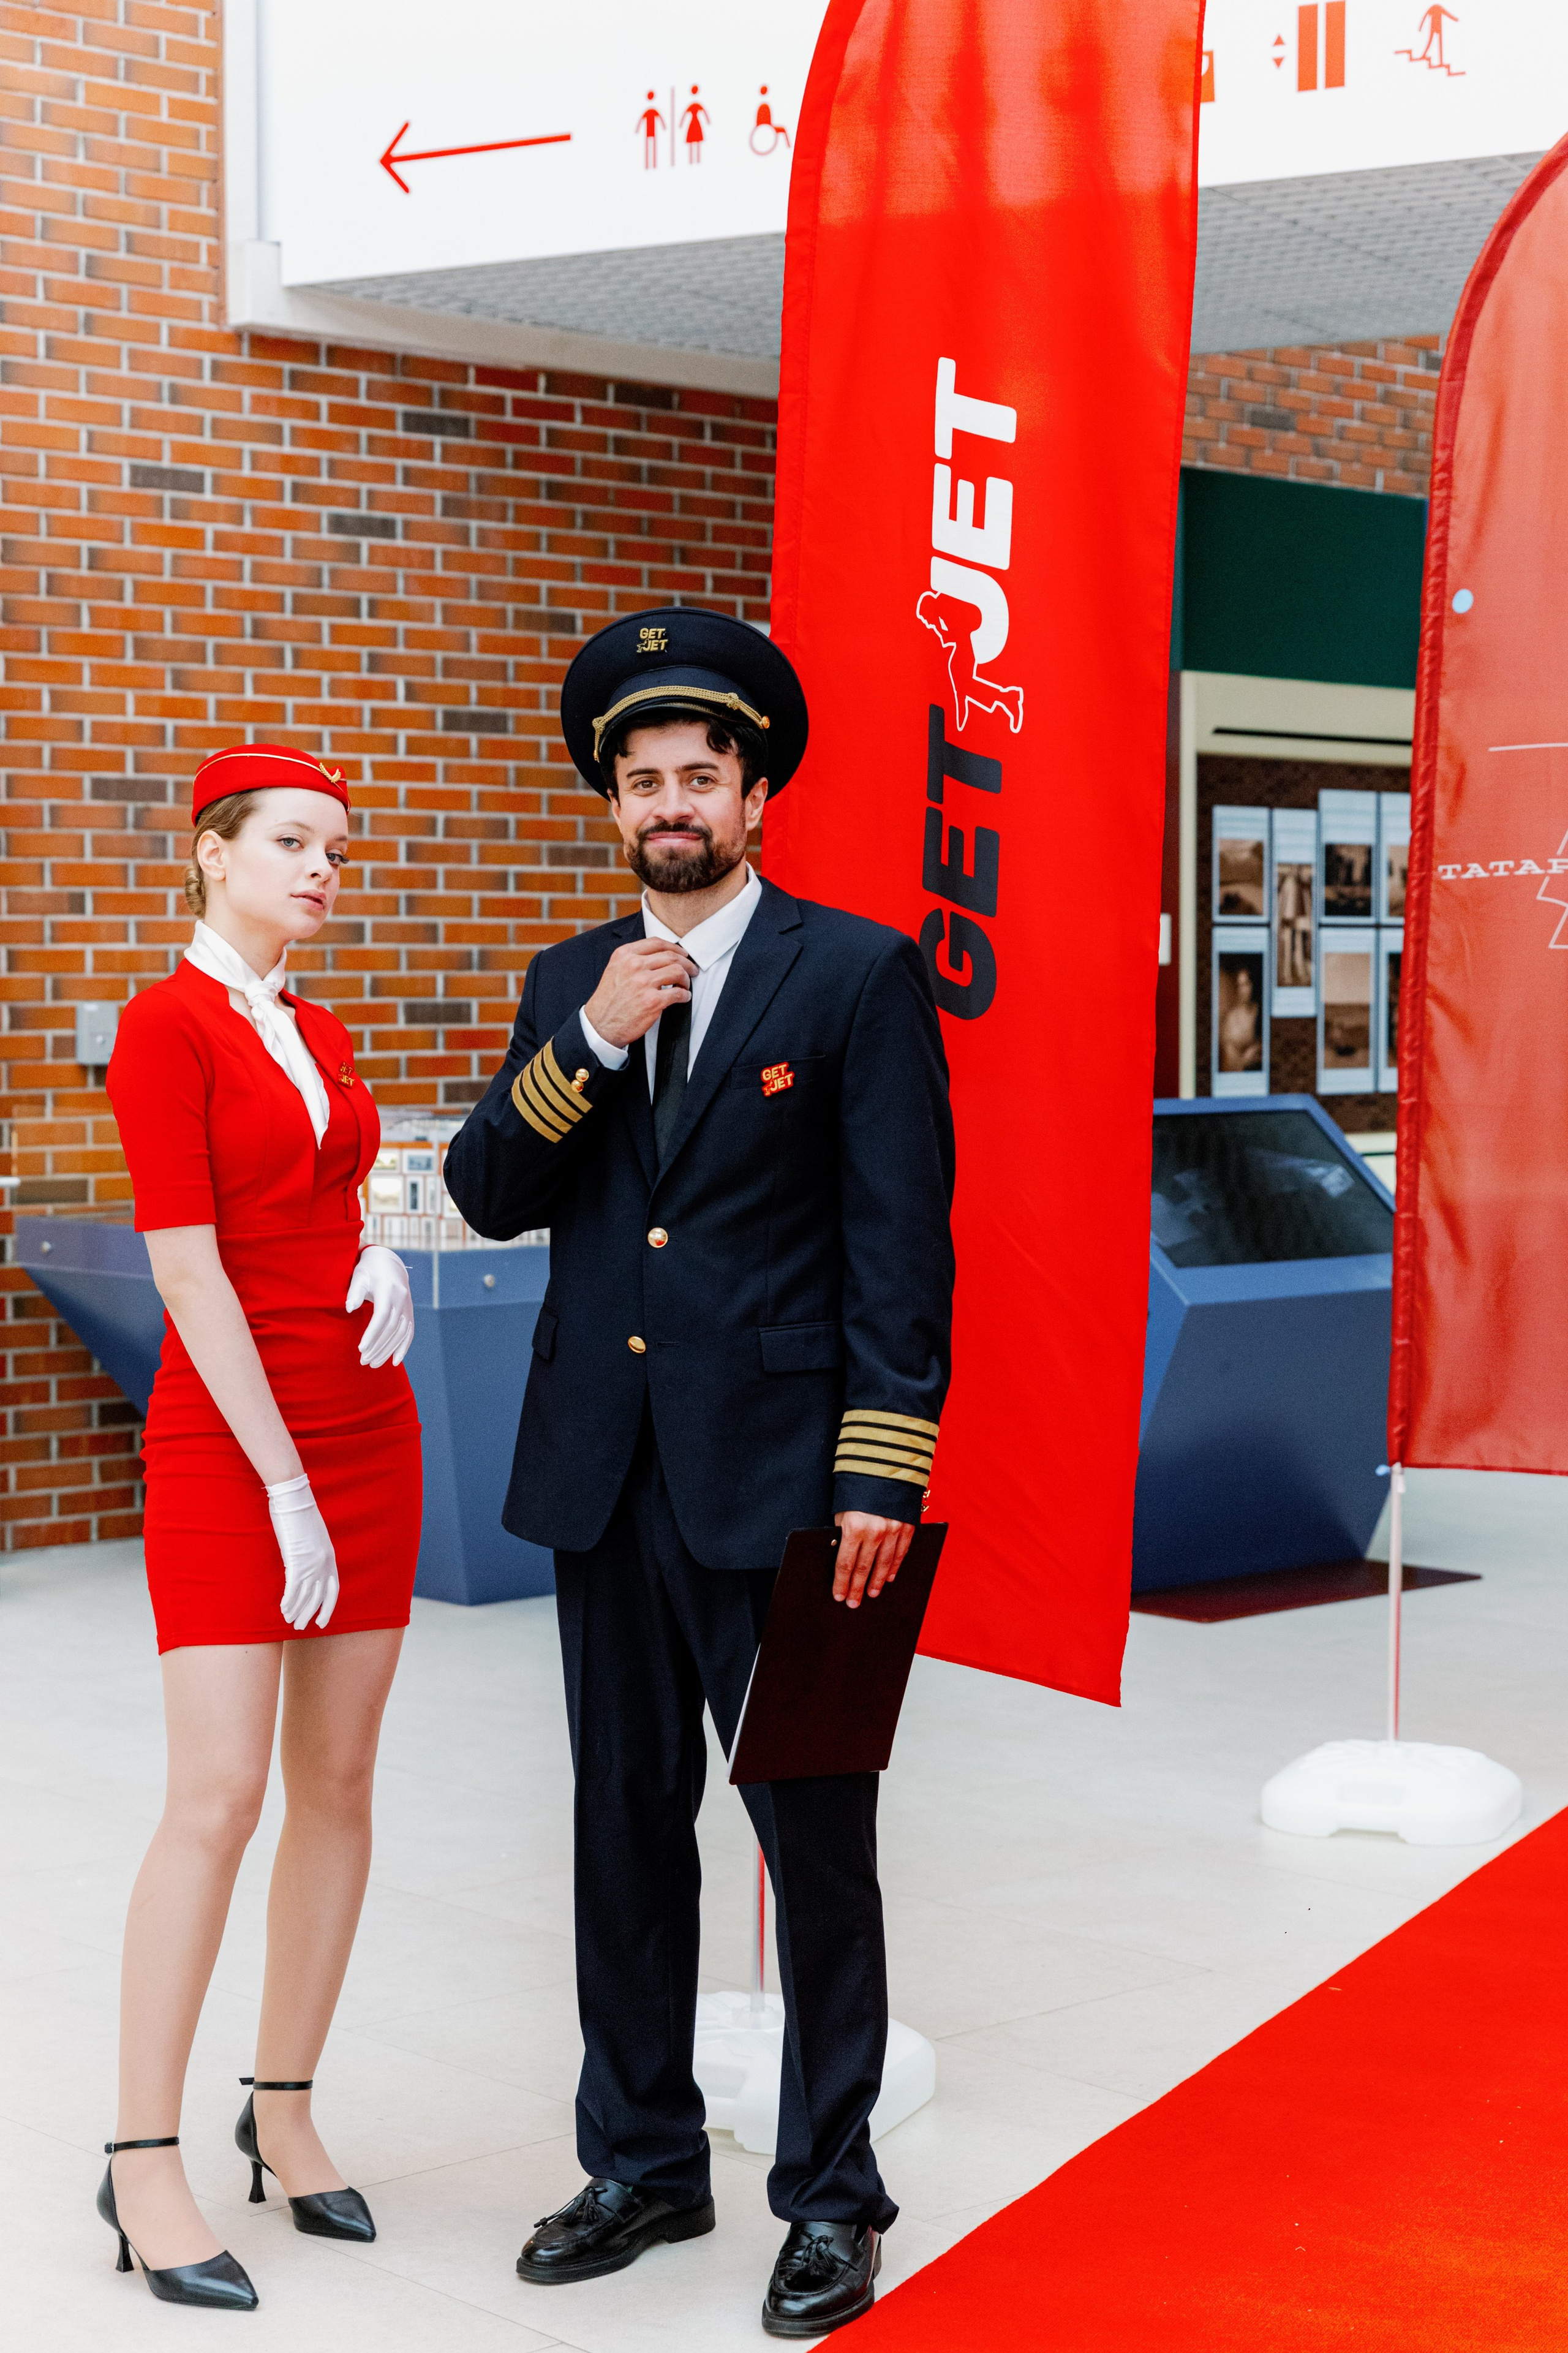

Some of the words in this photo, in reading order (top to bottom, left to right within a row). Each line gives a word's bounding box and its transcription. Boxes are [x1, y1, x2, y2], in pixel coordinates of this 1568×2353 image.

[930, 357, 1017, 664] JET
[639, 628, 666, 639] GET
[643, 639, 668, 651] JET
[919, 703, 1002, 1021] GET
[341, 1074, 355, 1087] JET
[762, 1064, 787, 1081] GET
[769, 1073, 793, 1092] JET
